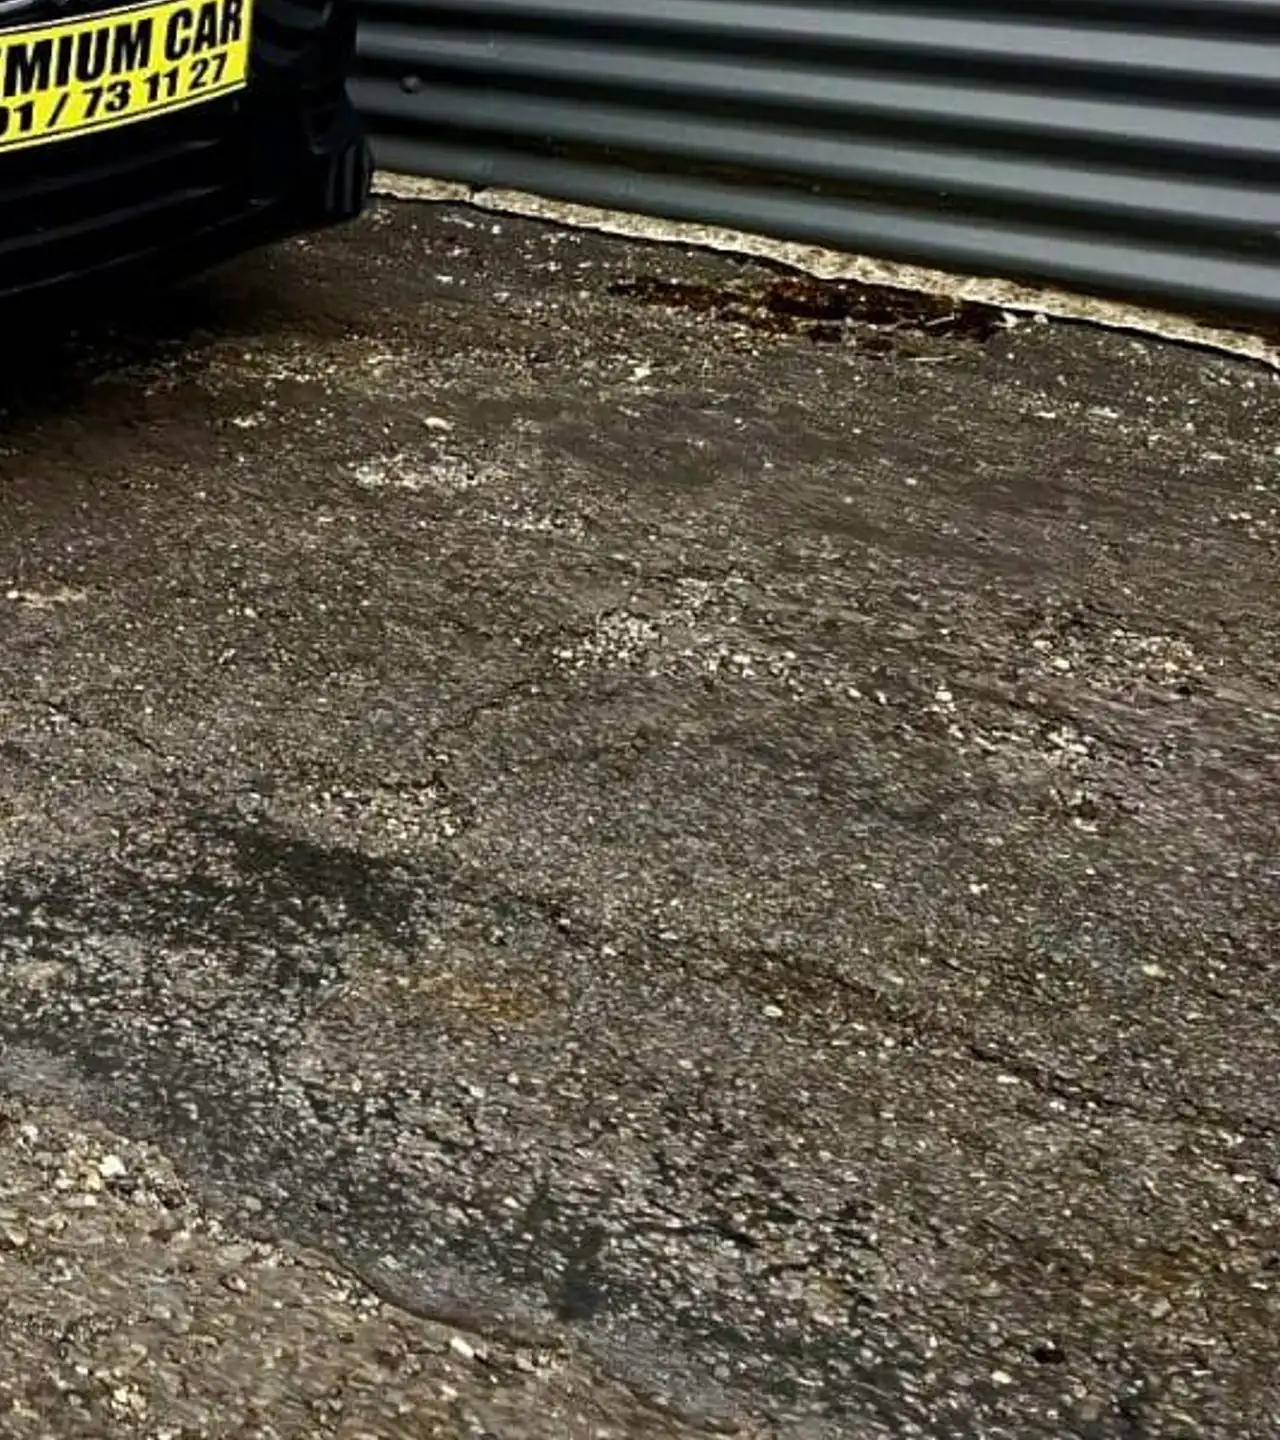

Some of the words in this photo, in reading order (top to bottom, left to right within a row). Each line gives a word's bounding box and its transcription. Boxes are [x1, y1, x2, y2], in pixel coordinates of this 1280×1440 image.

[47, 93, 70, 128] /
[83, 80, 132, 118] 73
[143, 69, 180, 104] 11
[188, 52, 228, 92] 27
